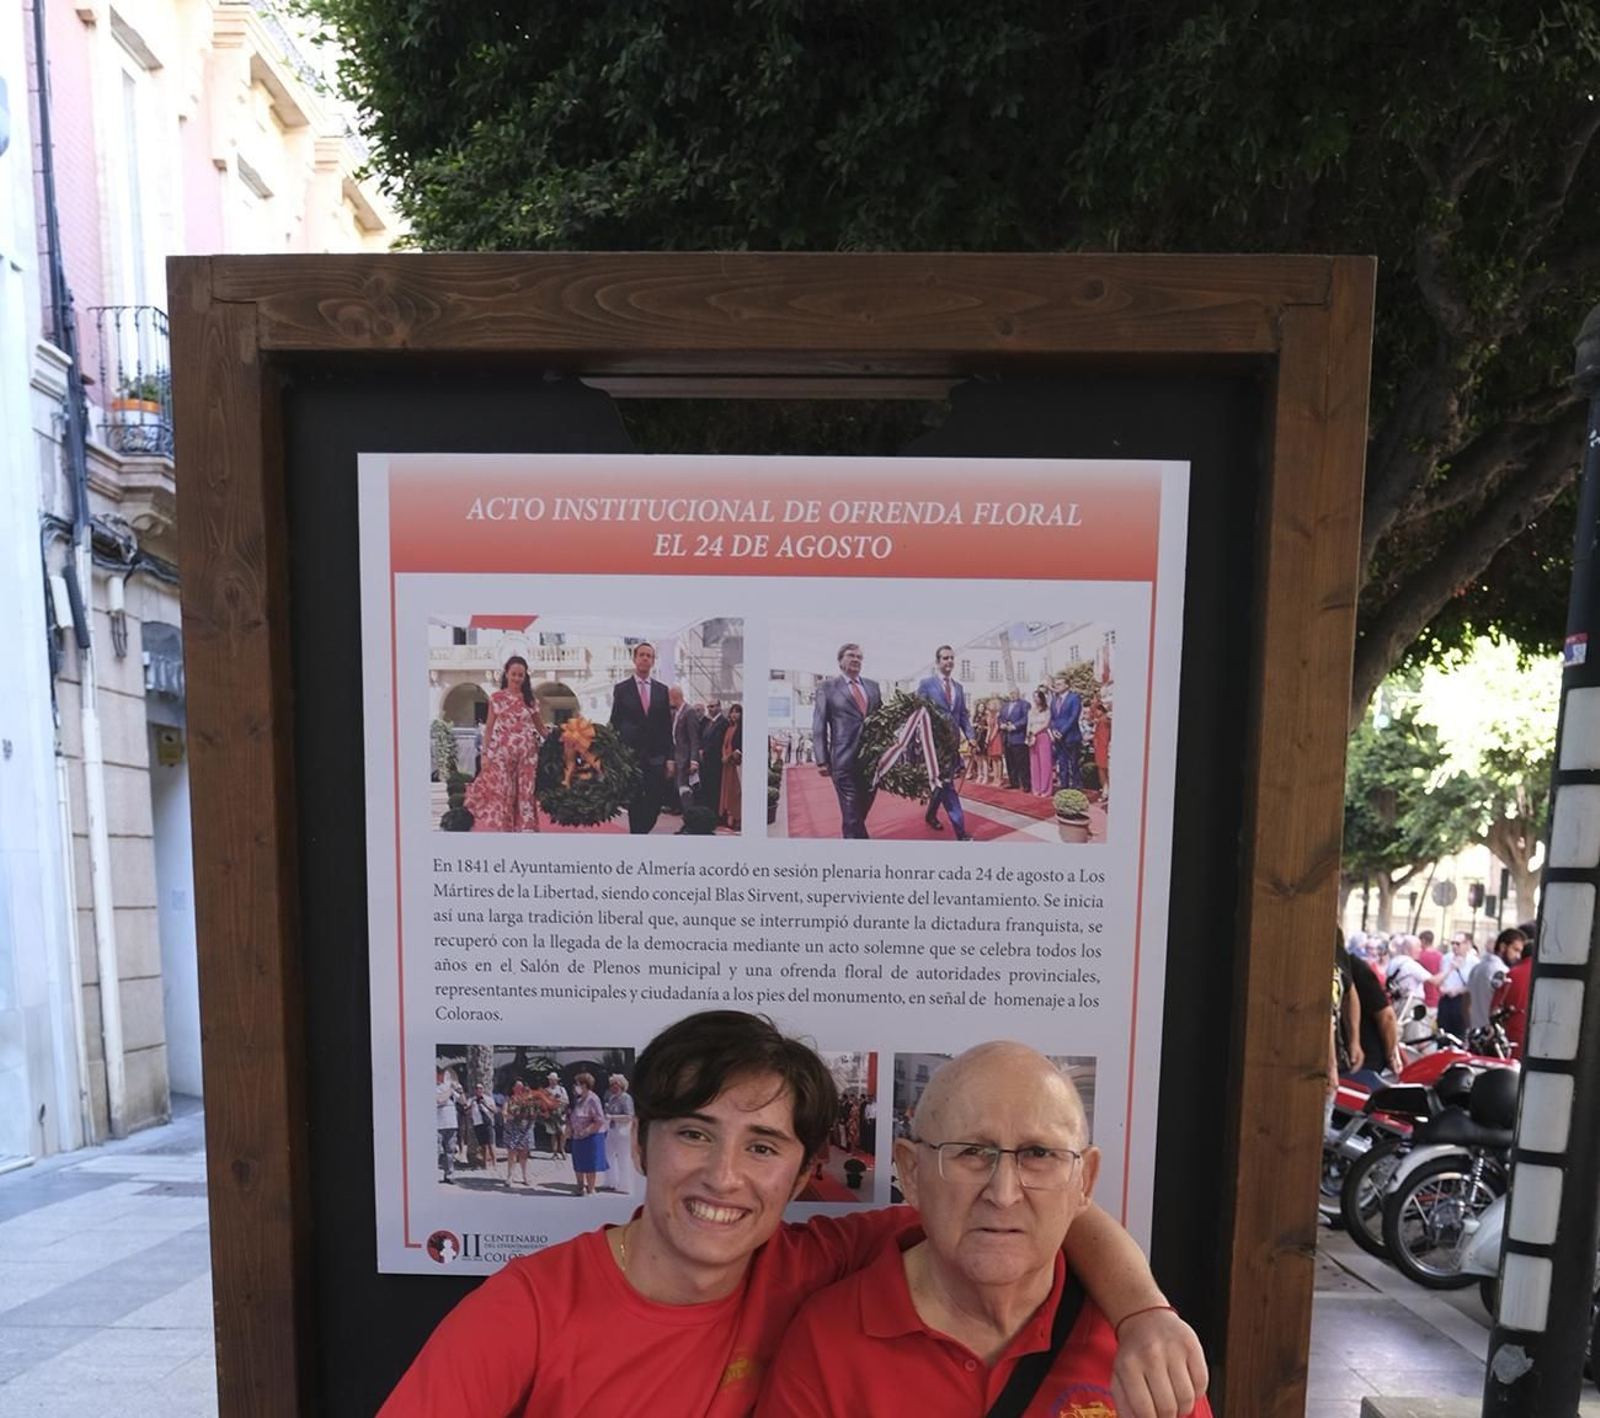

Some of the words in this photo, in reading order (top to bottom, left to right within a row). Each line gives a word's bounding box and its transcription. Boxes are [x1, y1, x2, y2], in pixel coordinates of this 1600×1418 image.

[466, 497, 545, 521] ACTO
[551, 498, 775, 523] INSTITUCIONAL
[783, 500, 822, 523] DE
[829, 500, 963, 525] OFRENDA
[971, 502, 1083, 527] FLORAL
[653, 533, 687, 557] EL
[694, 535, 724, 558] 24
[730, 535, 769, 558] DE
[775, 534, 893, 560] AGOSTO
[433, 858, 452, 873] En
[457, 859, 488, 873] 1841
[493, 858, 505, 874] el
[509, 860, 612, 879] Ayuntamiento
[615, 860, 633, 876] de
[636, 860, 695, 876] Almería
[698, 861, 749, 877] acordó
[752, 866, 769, 877] en
[773, 863, 818, 878] sesión
[822, 863, 881, 883] plenaria
[884, 864, 935, 880] honrar
[938, 865, 971, 881] cada
[975, 867, 992, 881] 24
[995, 866, 1014, 882] de
[1016, 870, 1064, 887] agosto
[1067, 872, 1075, 883] a
[1079, 868, 1105, 883] Los
[433, 883, 494, 898] Mártires
[496, 883, 514, 899] de
[517, 883, 530, 899] la
[533, 884, 598, 901] Libertad,
[601, 885, 649, 901] siendo
[651, 886, 711, 906] concejal
[715, 887, 744, 903] Blas
[747, 888, 803, 904] Sirvent,
[806, 890, 905, 909] superviviente
[907, 890, 929, 906] del
[933, 891, 1040, 907] levantamiento.
[1043, 893, 1060, 908] Se
[1063, 894, 1103, 909] inicia
[433, 908, 452, 923] así
[457, 912, 484, 923] una
[488, 908, 523, 928] larga
[528, 909, 593, 924] tradición
[598, 910, 643, 925] liberal
[647, 915, 678, 930] que,
[682, 915, 736, 931] aunque
[740, 916, 755, 928] se
[760, 914, 848, 933] interrumpió
[852, 914, 909, 930] durante
[914, 915, 926, 931] la
[930, 915, 1000, 931] dictadura
[1005, 917, 1083, 937] franquista,
[1088, 923, 1103, 934] se
[434, 933, 497, 952] recuperó
[501, 937, 528, 948] con
[532, 933, 545, 949] la
[550, 934, 600, 954] llegada
[604, 934, 622, 950] de
[627, 935, 639, 950] la
[643, 935, 728, 951] democracia
[733, 937, 800, 953] mediante
[804, 943, 823, 954] un
[828, 942, 859, 954] acto
[863, 939, 925, 955] solemne
[929, 945, 956, 960] que
[960, 945, 975, 956] se
[979, 941, 1031, 957] celebra
[1036, 942, 1076, 958] todos
[1080, 943, 1101, 959] los
[434, 958, 467, 972] años
[474, 961, 492, 972] en
[500, 957, 513, 973] el
[520, 958, 559, 973] Salón
[567, 959, 585, 974] de
[593, 959, 640, 975] Plenos
[648, 960, 720, 980] municipal
[728, 966, 737, 981] y
[745, 966, 772, 977] una
[780, 962, 836, 978] ofrenda
[844, 963, 882, 979] floral
[890, 964, 908, 980] de
[916, 965, 1001, 981] autoridades
[1008, 967, 1100, 987] provinciales,
[434, 983, 537, 1002] representantes
[540, 983, 627, 1003] municipales
[629, 989, 638, 1004] y
[640, 985, 719, 1000] ciudadanía
[722, 991, 730, 1001] a
[733, 986, 753, 1001] los
[756, 988, 785, 1006] pies
[787, 987, 809, 1003] del
[813, 991, 905, 1005] monumento,
[908, 994, 925, 1005] en
[928, 990, 965, 1005] señal
[968, 990, 986, 1006] de
[994, 991, 1065, 1011] homenaje
[1067, 997, 1075, 1008] a
[1078, 993, 1099, 1008] los
[435, 1006, 502, 1021] Coloraos.
[462, 1233, 482, 1257] II
[484, 1234, 548, 1244] CENTENARIO
